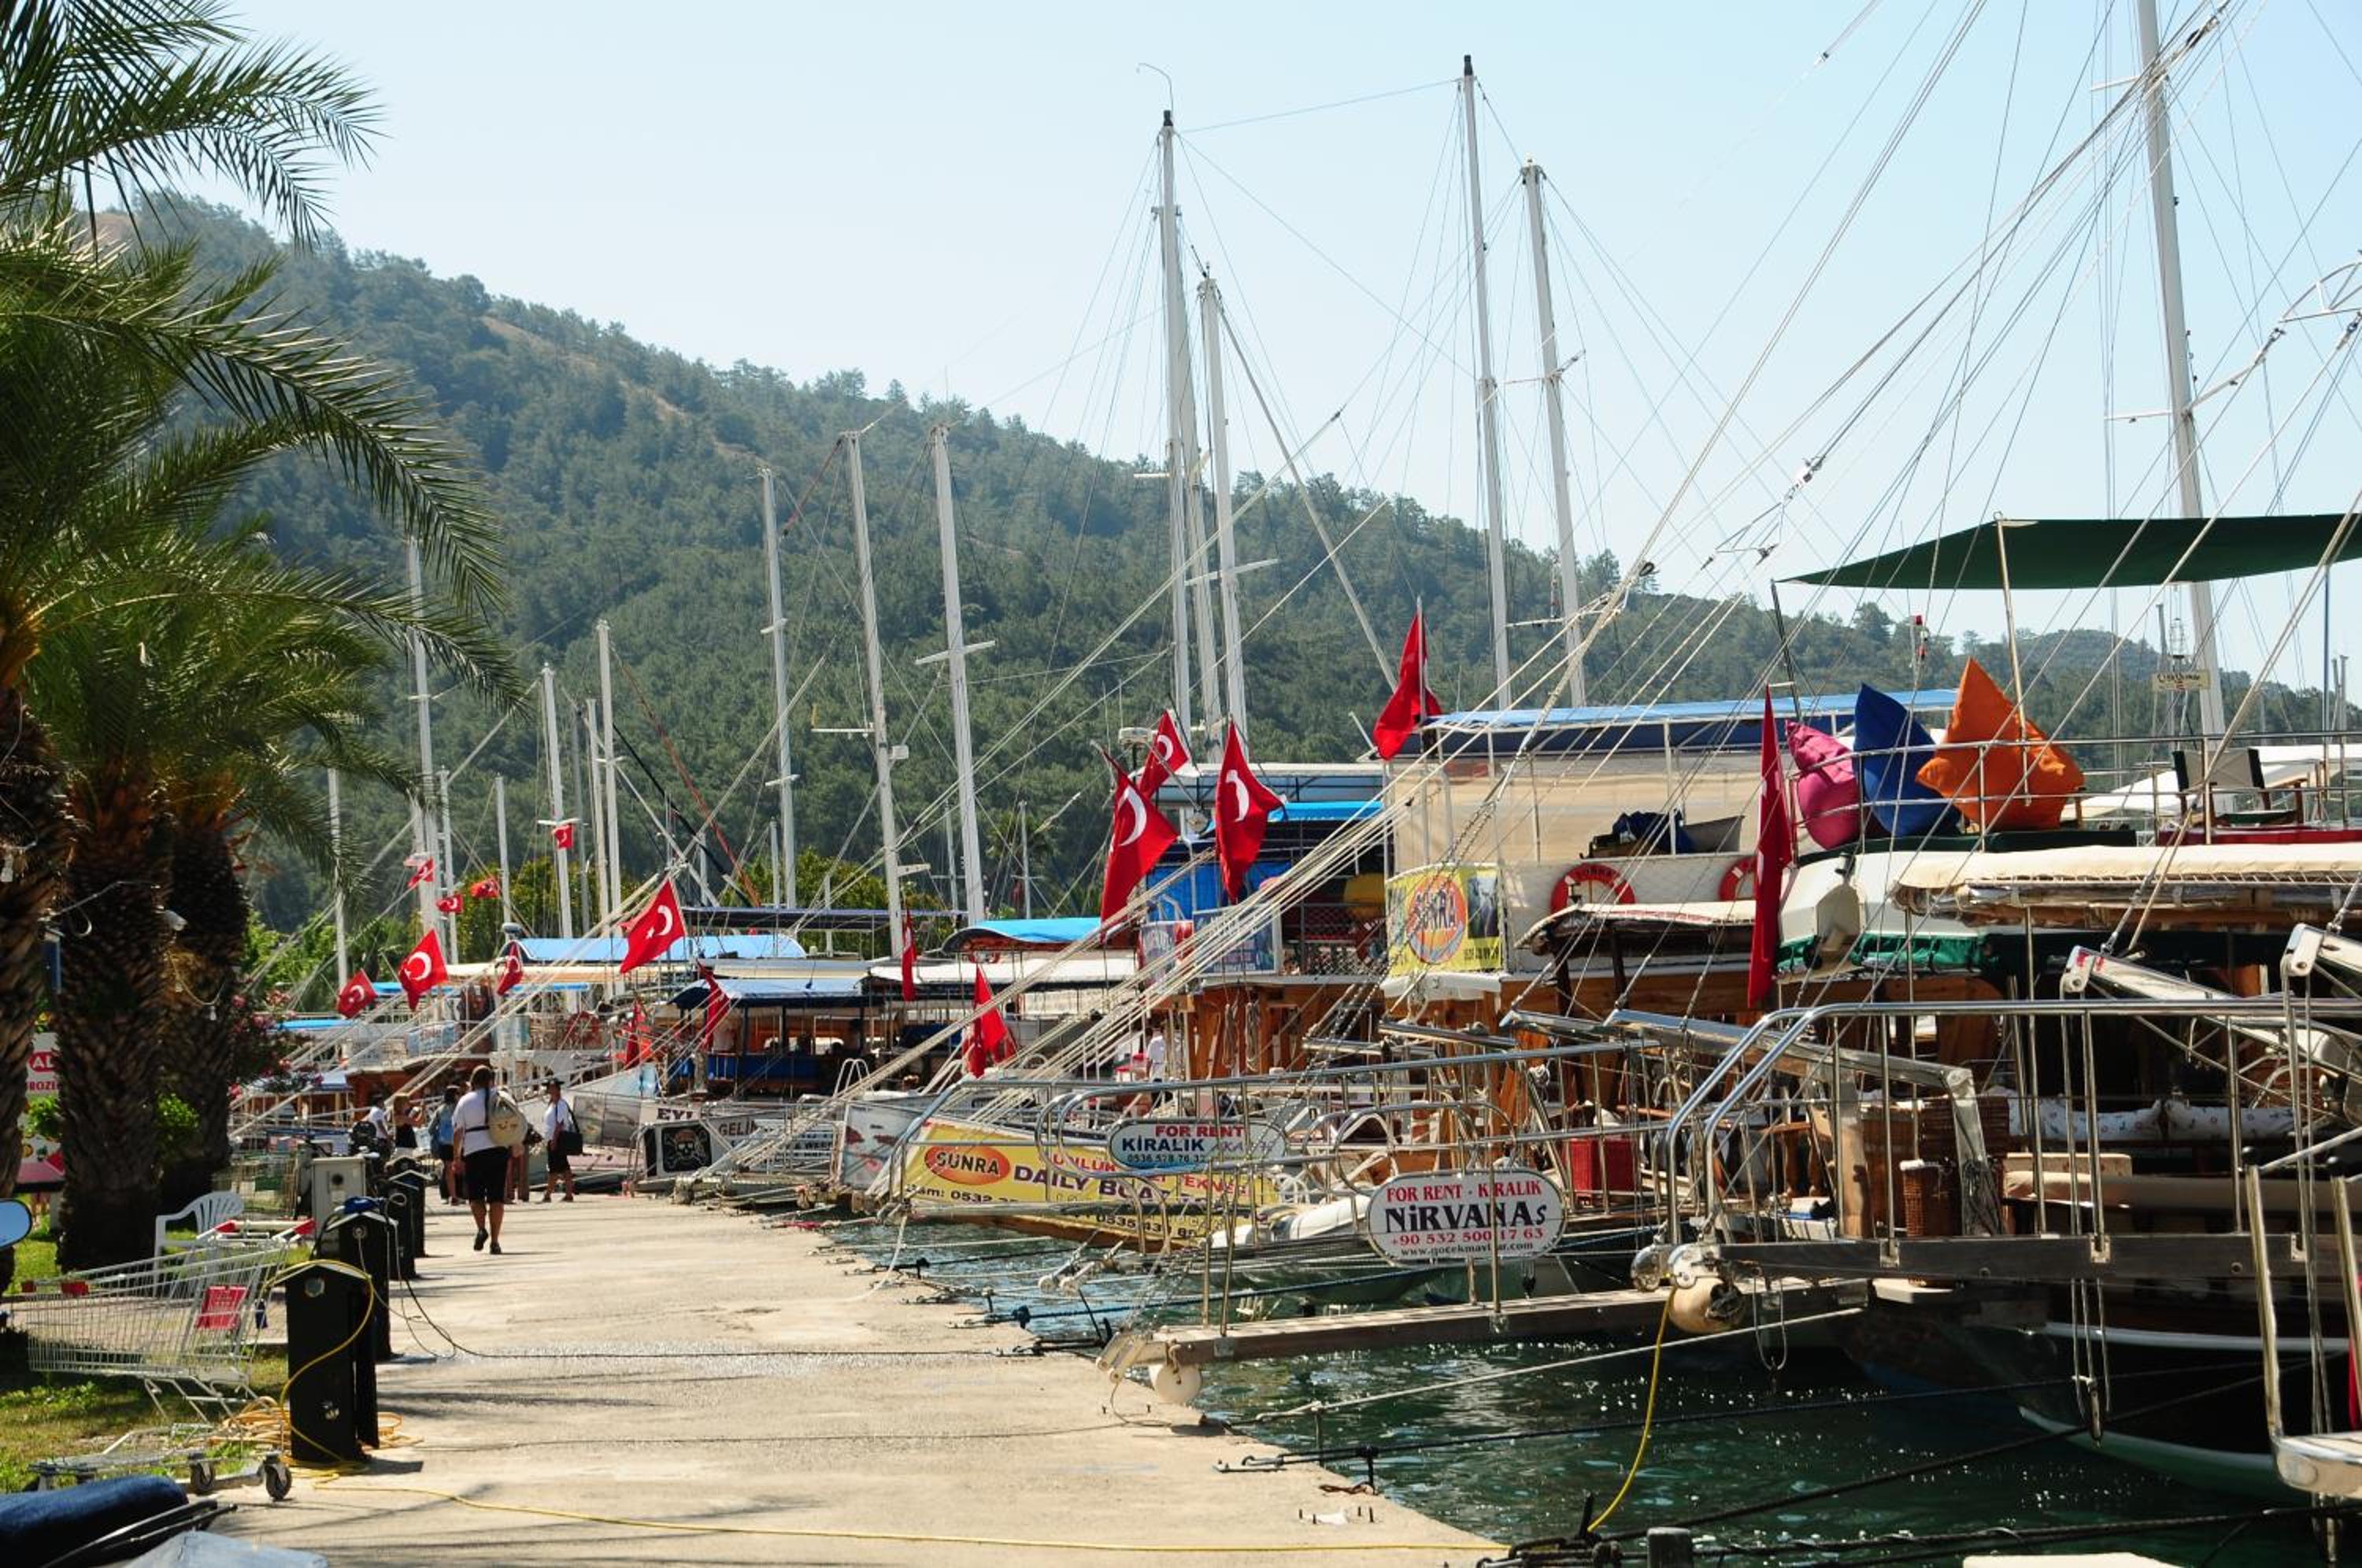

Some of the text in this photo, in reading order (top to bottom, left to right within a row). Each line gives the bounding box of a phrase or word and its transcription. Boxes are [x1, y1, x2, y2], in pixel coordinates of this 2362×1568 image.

[1155, 1126, 1244, 1137] FOR RENT
[1121, 1134, 1205, 1152] KİRALIK
[936, 1152, 1000, 1175] SUNRA
[1013, 1165, 1089, 1190] DAILY
[1386, 1180, 1542, 1202] FOR RENT KRALIK
[1392, 1227, 1544, 1245] +90 532 500 17 63
